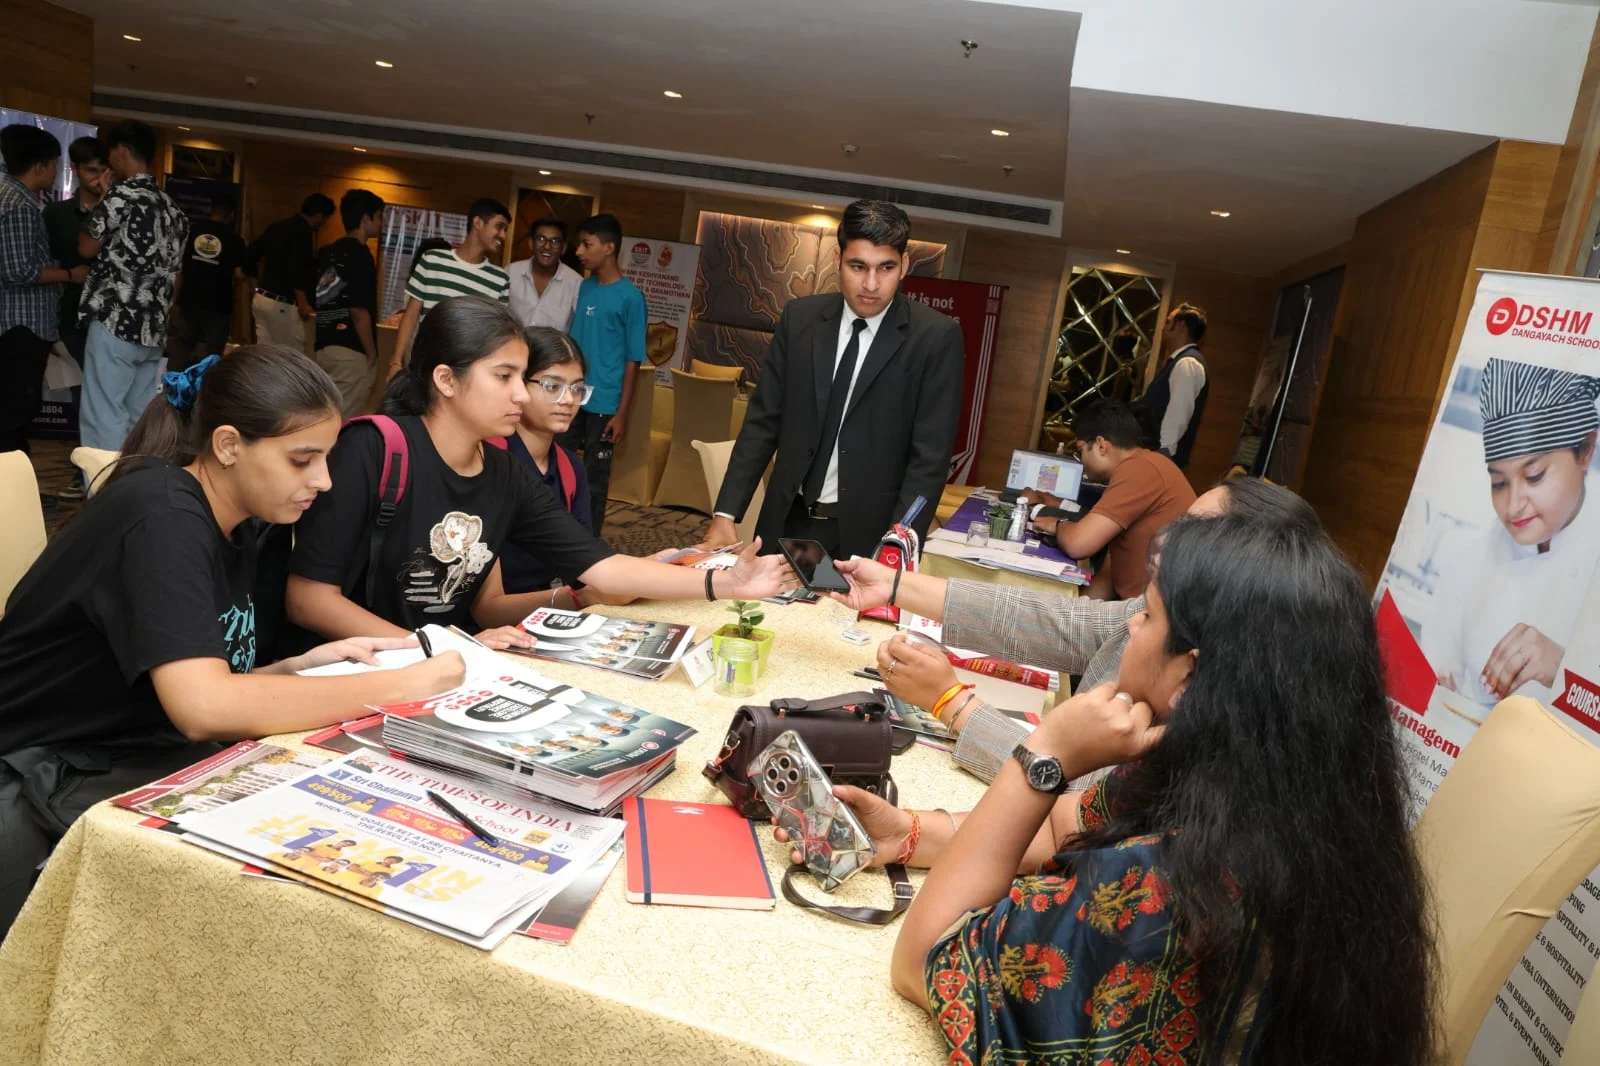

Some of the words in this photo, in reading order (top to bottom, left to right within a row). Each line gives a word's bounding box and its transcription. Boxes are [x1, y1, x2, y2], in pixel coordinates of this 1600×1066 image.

[919, 292, 930, 305] is
[932, 297, 954, 309] not
[1515, 304, 1593, 335] DSHM
[1511, 328, 1565, 344] DANGAYACH
[350, 775, 367, 785] Sri
[367, 779, 423, 802] Chaitanya
[378, 763, 418, 783] THE
[419, 777, 479, 801] TIMES
[481, 798, 513, 811] OF
[511, 807, 572, 832] INDIA
[315, 800, 342, 813] WHEN
[343, 810, 361, 819] THE
[360, 817, 386, 830] GOAL
[395, 827, 413, 838] SET
[412, 833, 429, 844] AT
[428, 840, 444, 849] SRI
[358, 821, 375, 831] THE
[374, 827, 410, 842] RESULT
[474, 815, 519, 835] School
[1545, 940, 1586, 989] HOSPITALITY
[1513, 988, 1536, 1021] BAKERY
[1533, 1016, 1541, 1028] &
[1508, 1011, 1515, 1023] &
[1513, 1018, 1533, 1048] EVENT
